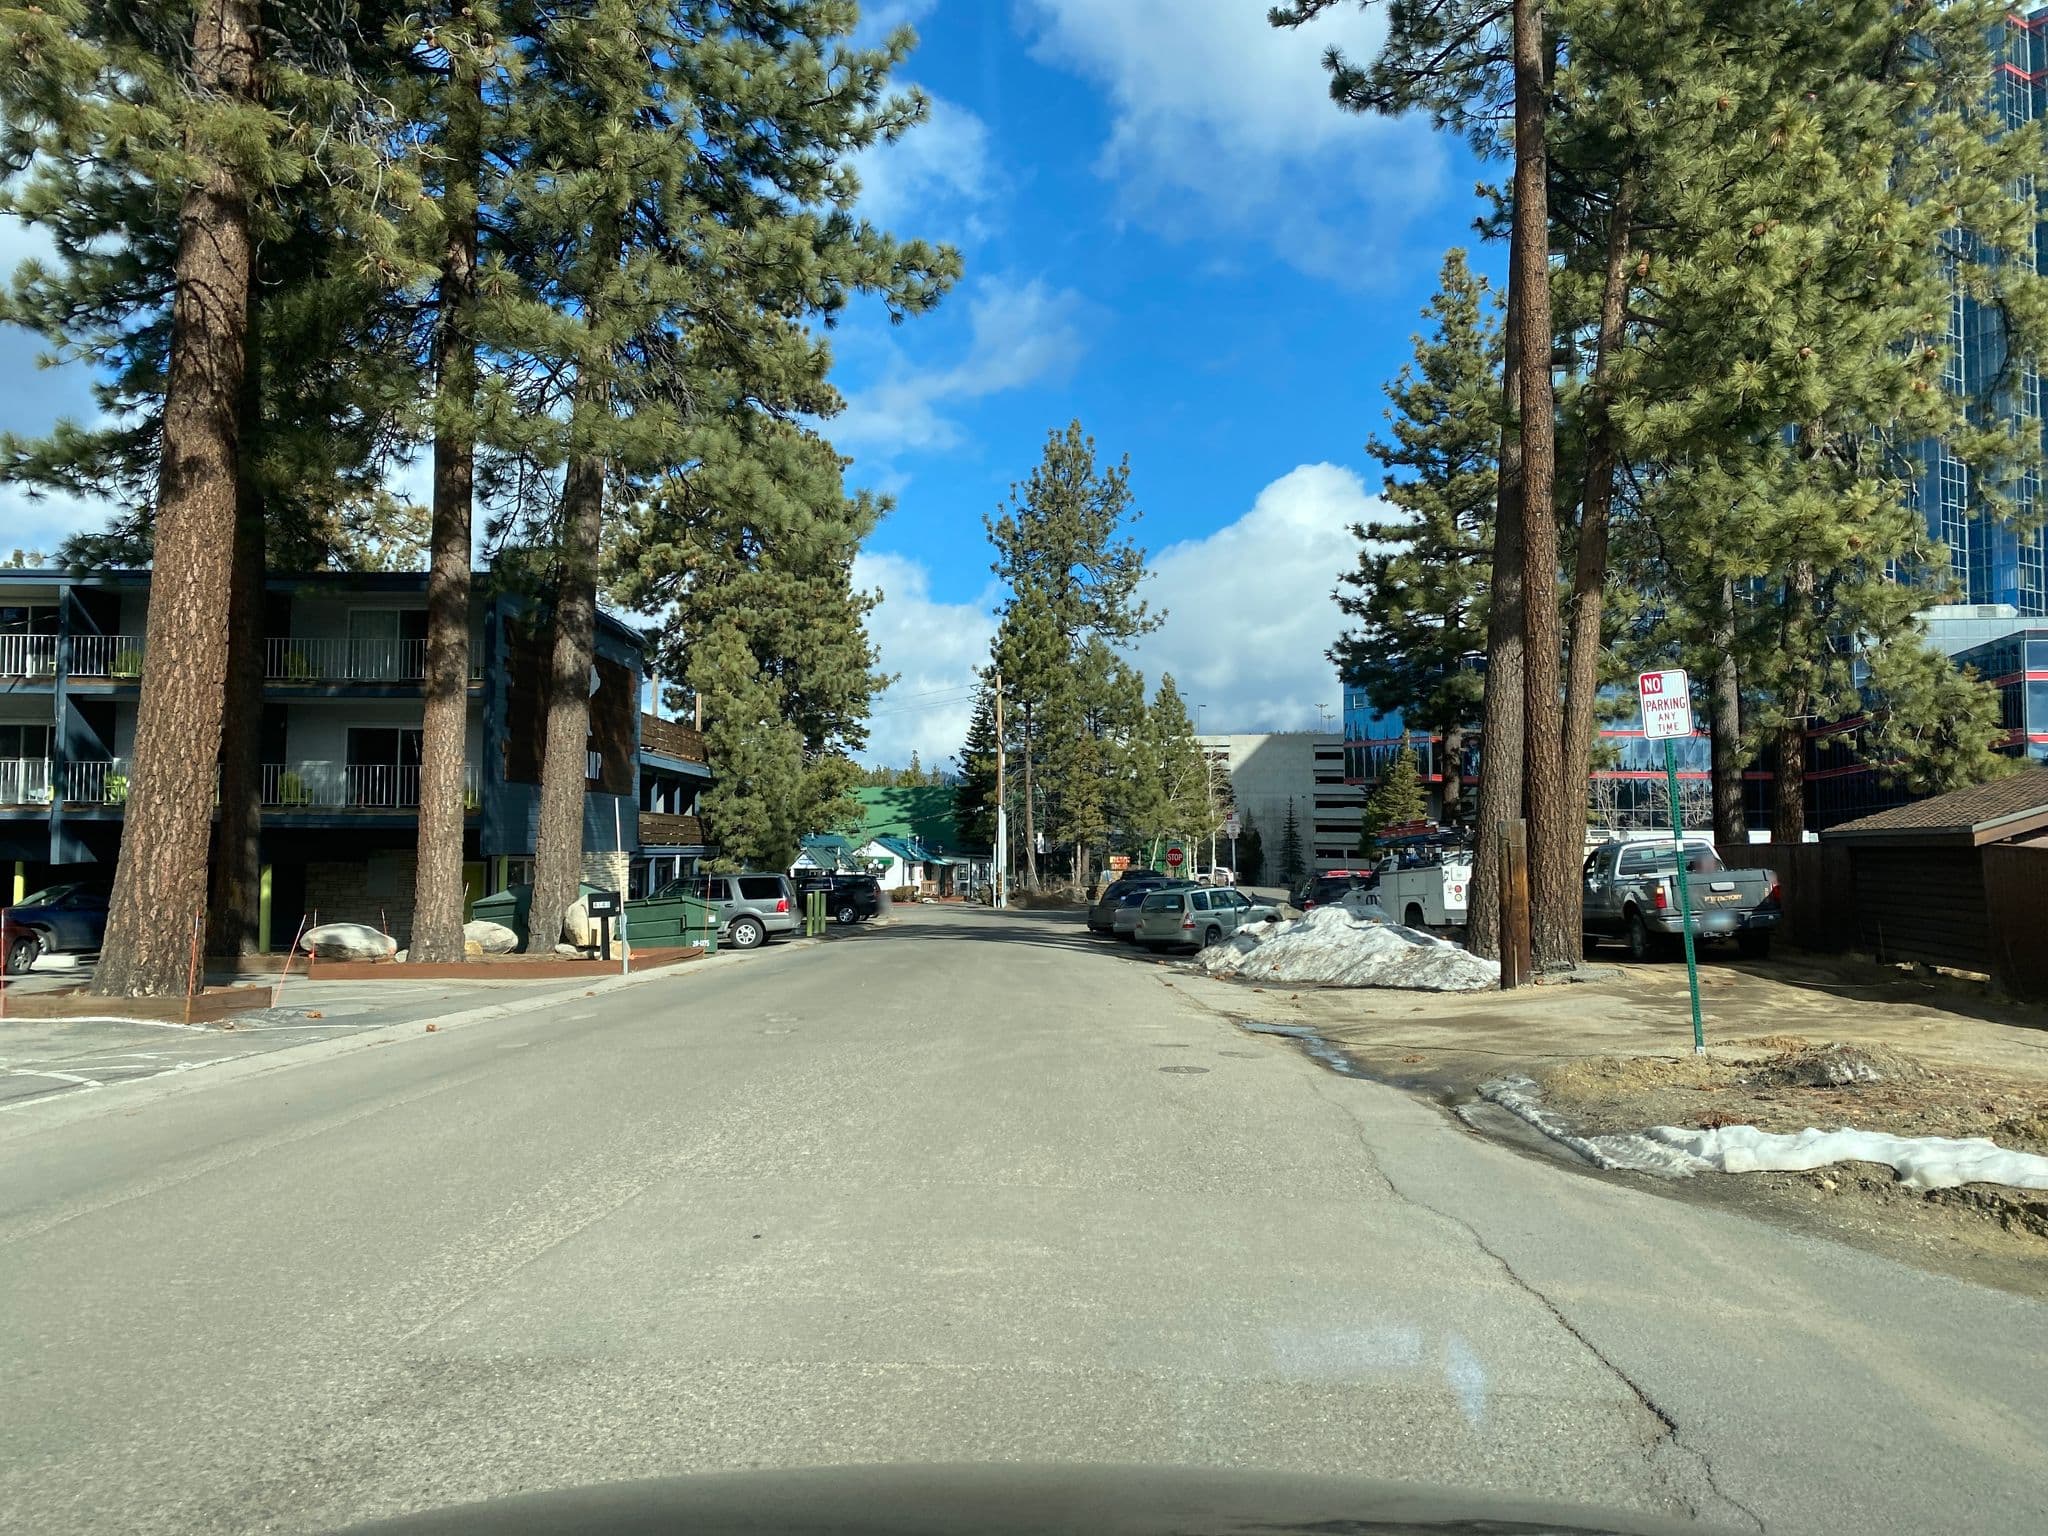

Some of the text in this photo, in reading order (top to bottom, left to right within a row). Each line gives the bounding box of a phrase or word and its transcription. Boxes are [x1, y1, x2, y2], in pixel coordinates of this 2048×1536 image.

[1644, 678, 1660, 692] NO
[1646, 697, 1686, 712] PARKING
[1659, 712, 1676, 721] ANY
[1658, 722, 1680, 732] TIME
[1167, 853, 1183, 861] STOP
